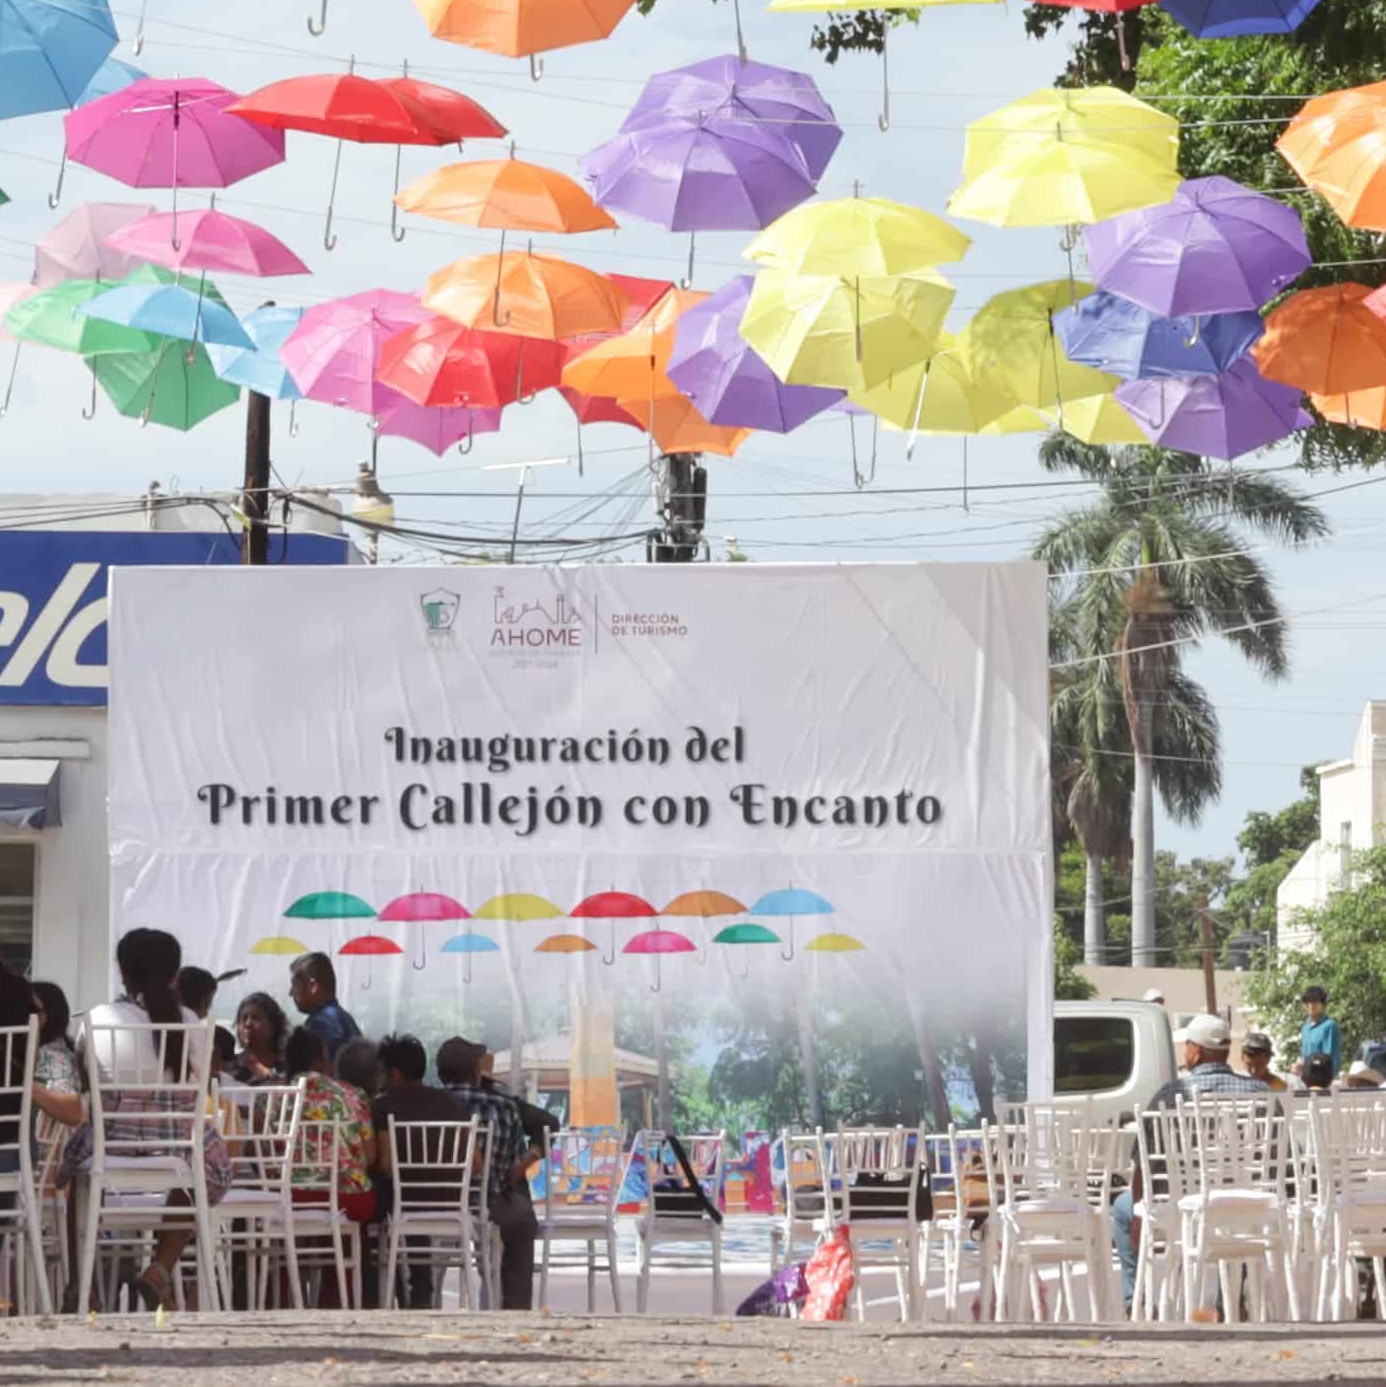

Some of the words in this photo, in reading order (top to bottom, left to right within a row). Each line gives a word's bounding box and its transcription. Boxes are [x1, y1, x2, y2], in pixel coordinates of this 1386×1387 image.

[612, 612, 680, 624] DIRECCIÓN
[490, 628, 582, 646] AHOME
[612, 625, 627, 636] DE
[631, 625, 688, 636] TURISMO
[384, 726, 671, 774] Inauguración
[685, 726, 745, 763] del
[197, 783, 380, 826] Primer
[400, 782, 603, 837] Callejón
[623, 794, 710, 828] con
[730, 783, 944, 828] Encanto
